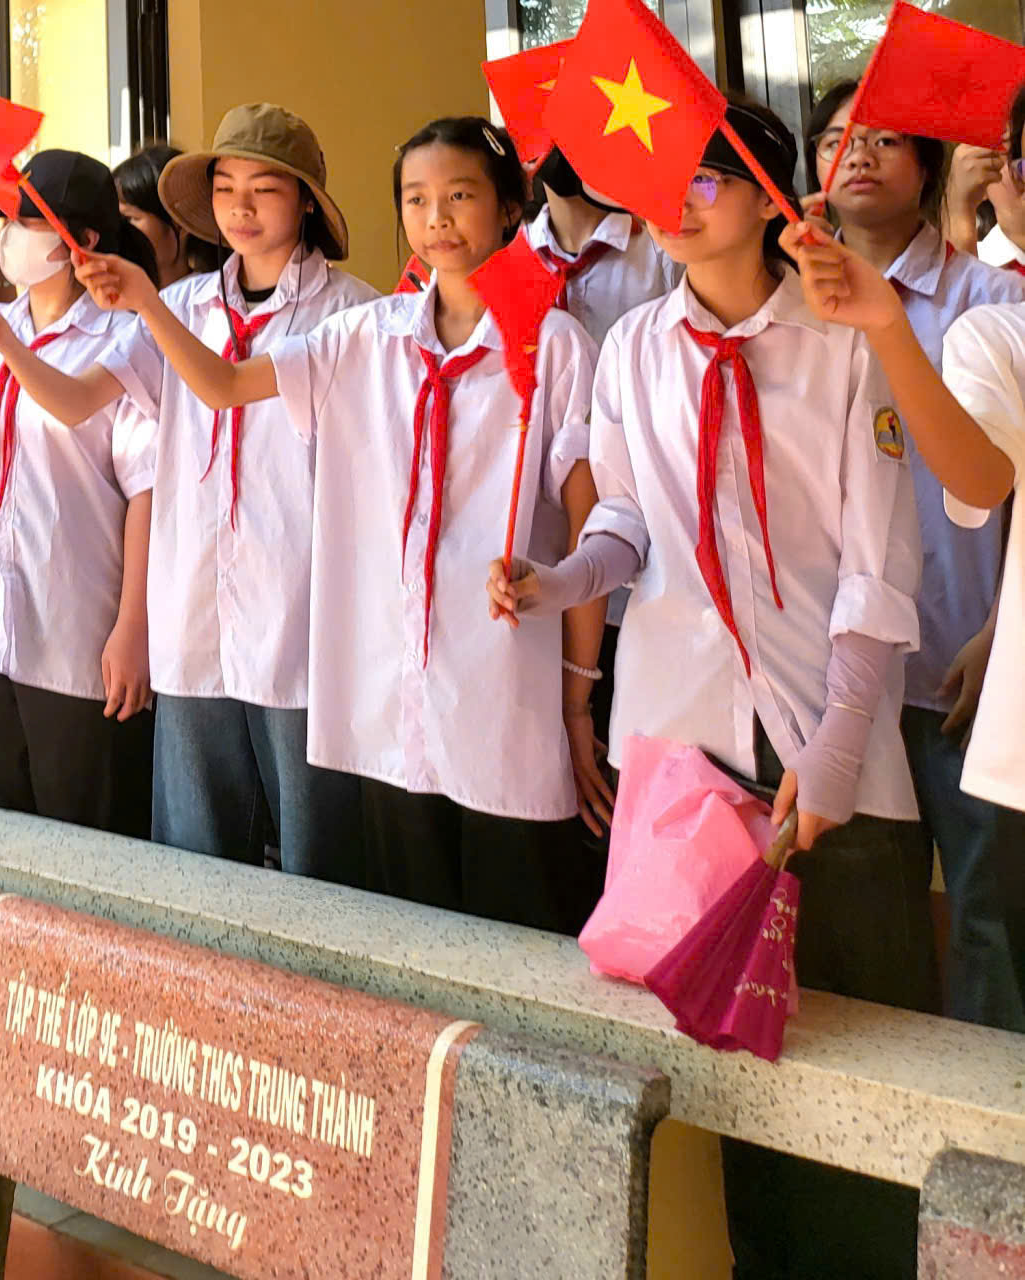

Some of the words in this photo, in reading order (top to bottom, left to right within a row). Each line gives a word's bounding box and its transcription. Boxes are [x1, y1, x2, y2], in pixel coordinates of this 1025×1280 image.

[6, 968, 35, 1045] TẬP
[35, 970, 70, 1048] THỂ
[65, 989, 99, 1058] LỚP
[98, 1010, 122, 1068] 9E
[133, 1015, 197, 1097] TRƯỜNG
[200, 1043, 244, 1112] THCS
[247, 1059, 307, 1135] TRUNG
[311, 1071, 375, 1158] THÀNH
[35, 1063, 111, 1126] KHÓA
[120, 1097, 197, 1154] 2019
[207, 1144, 218, 1156] -
[228, 1136, 313, 1199] 2023
[73, 1133, 152, 1205] Kính
[164, 1169, 247, 1250] Tặng
